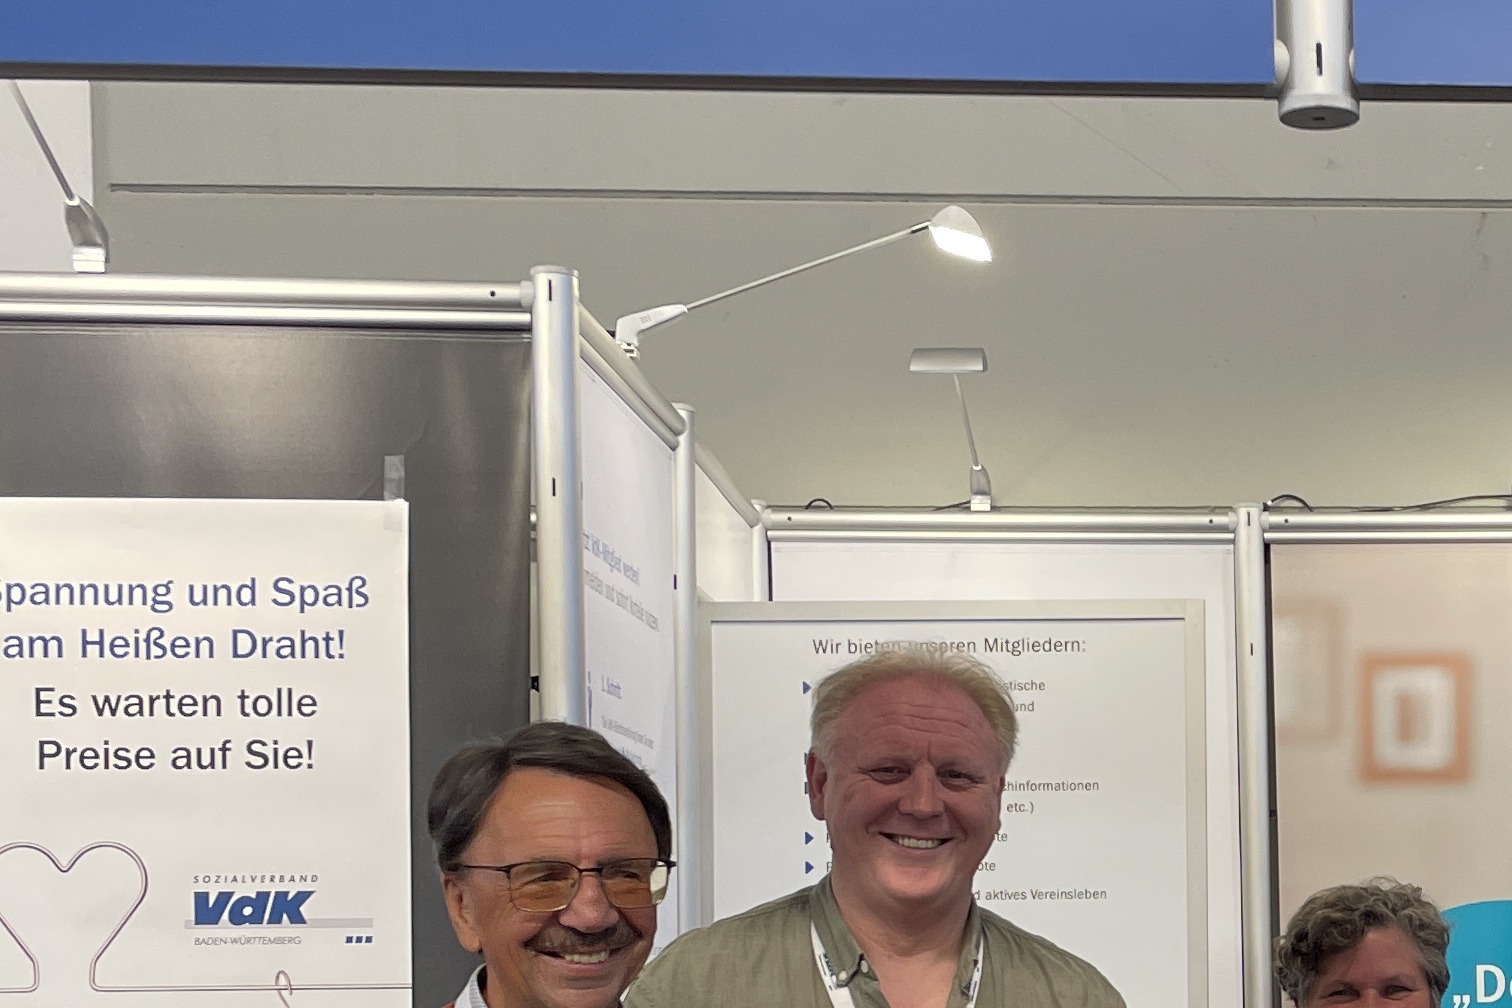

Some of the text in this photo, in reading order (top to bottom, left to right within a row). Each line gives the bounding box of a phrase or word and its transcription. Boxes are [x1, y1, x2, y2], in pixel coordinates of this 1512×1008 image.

[0, 576, 370, 613] pannung und Spaß
[3, 627, 346, 660] am Heißen Draht!
[813, 639, 842, 654] Wir
[847, 638, 900, 654] bieten
[984, 637, 1087, 657] Mitgliedern:
[1003, 680, 1046, 691] stische
[35, 687, 318, 717] Es warten tolle
[38, 739, 315, 770] Preise auf Sie!
[1003, 779, 1100, 792] chinformationen
[1006, 801, 1035, 815] etc.)
[193, 874, 319, 884] SOZIALVERBAND
[985, 889, 1027, 901] aktives
[1030, 888, 1107, 901] Vereinsleben
[193, 890, 317, 926] VdK
[194, 935, 302, 946] BADEN-WÜRTTEMBERG
